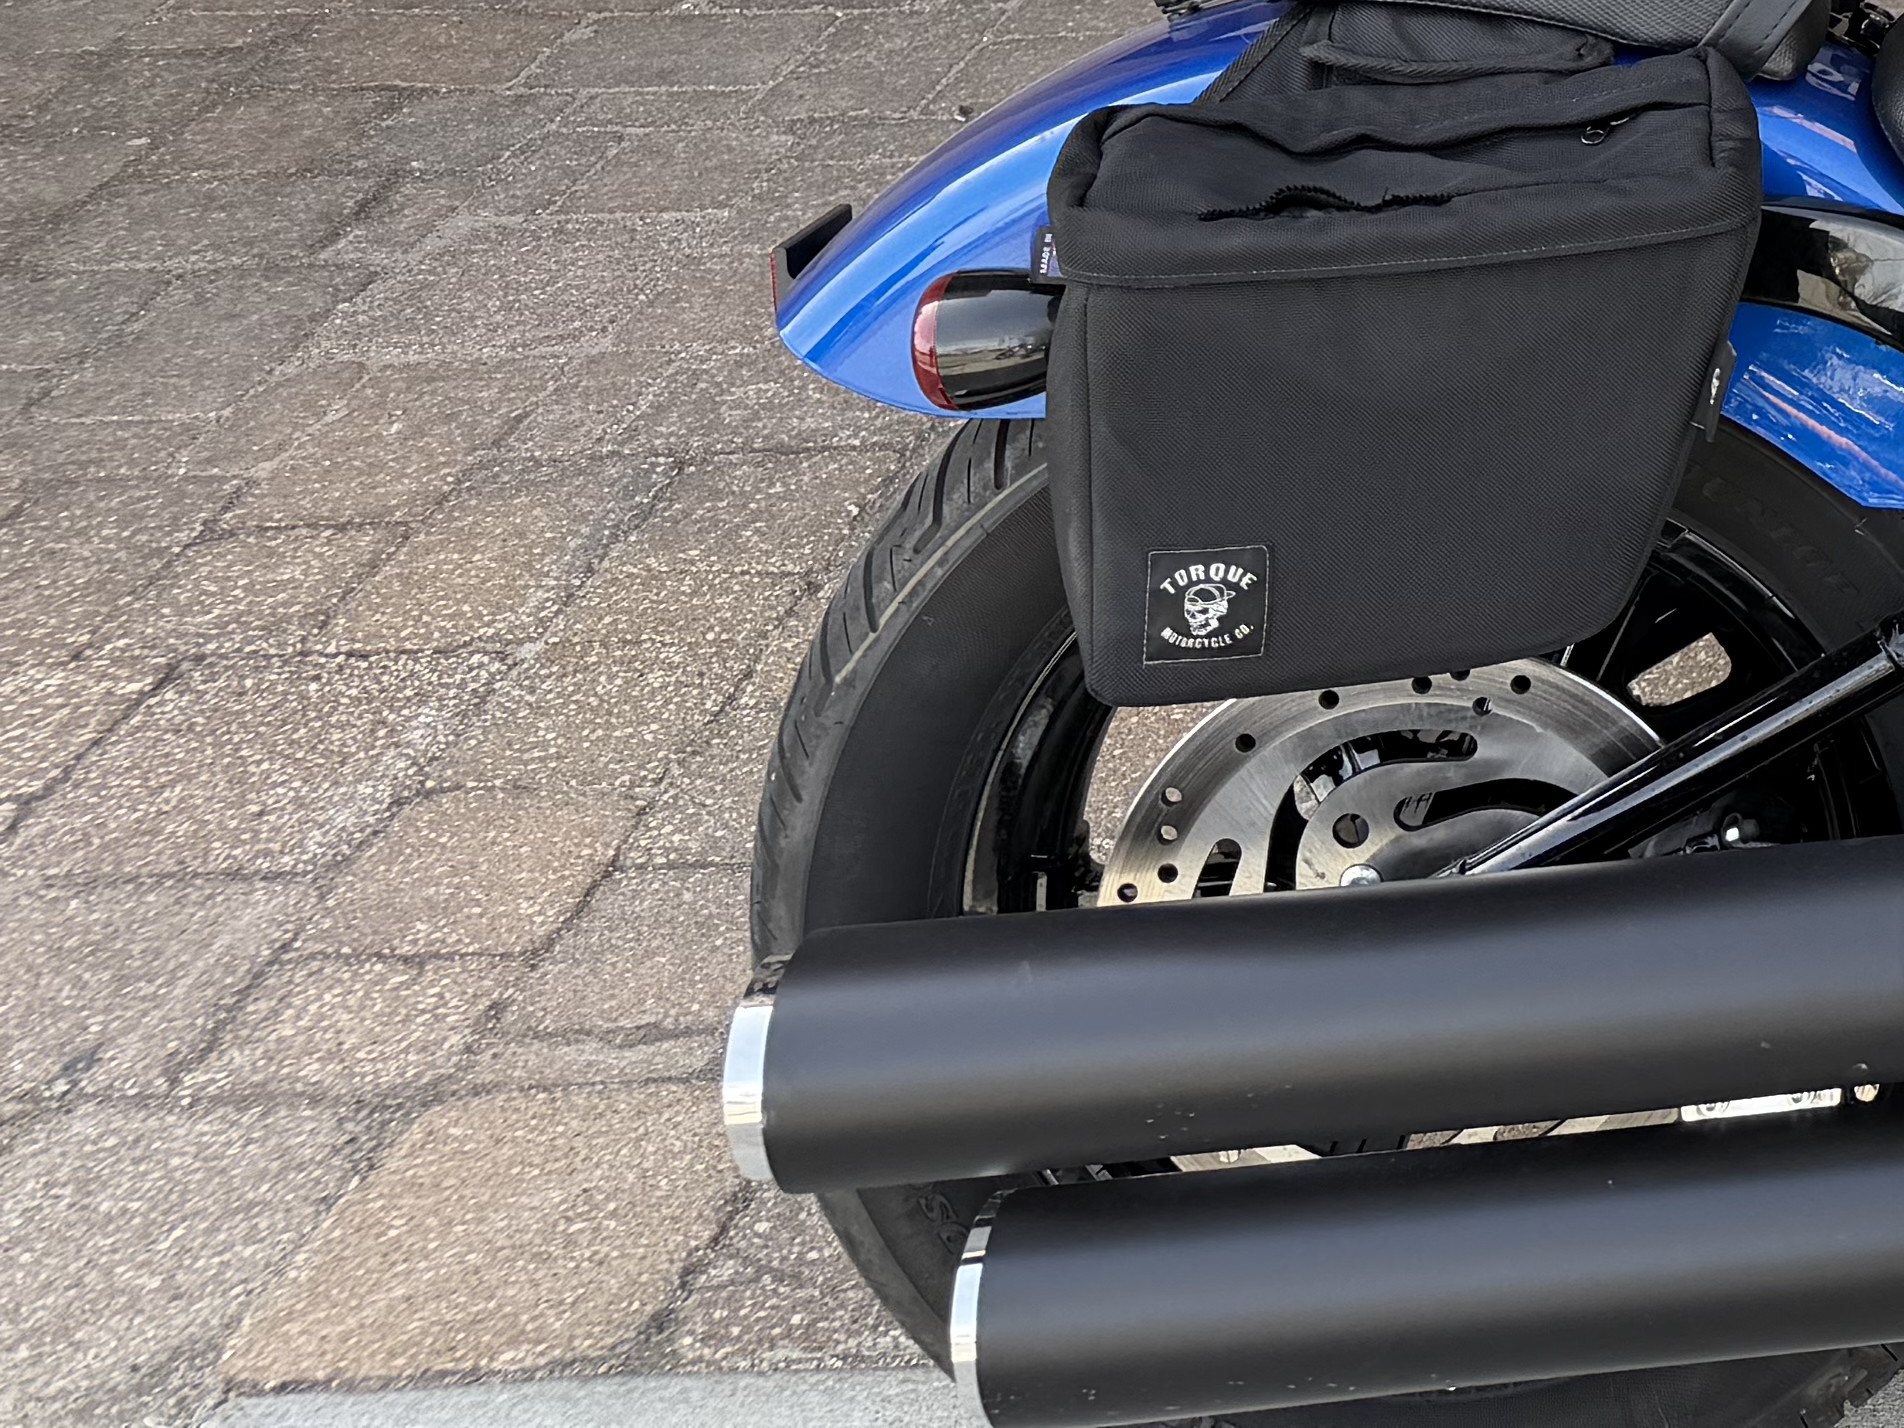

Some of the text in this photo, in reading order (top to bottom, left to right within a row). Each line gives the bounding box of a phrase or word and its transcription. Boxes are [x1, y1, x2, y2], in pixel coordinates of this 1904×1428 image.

[1159, 562, 1259, 595] TORQUE
[1160, 623, 1255, 650] MOTORCYCLE CO.
